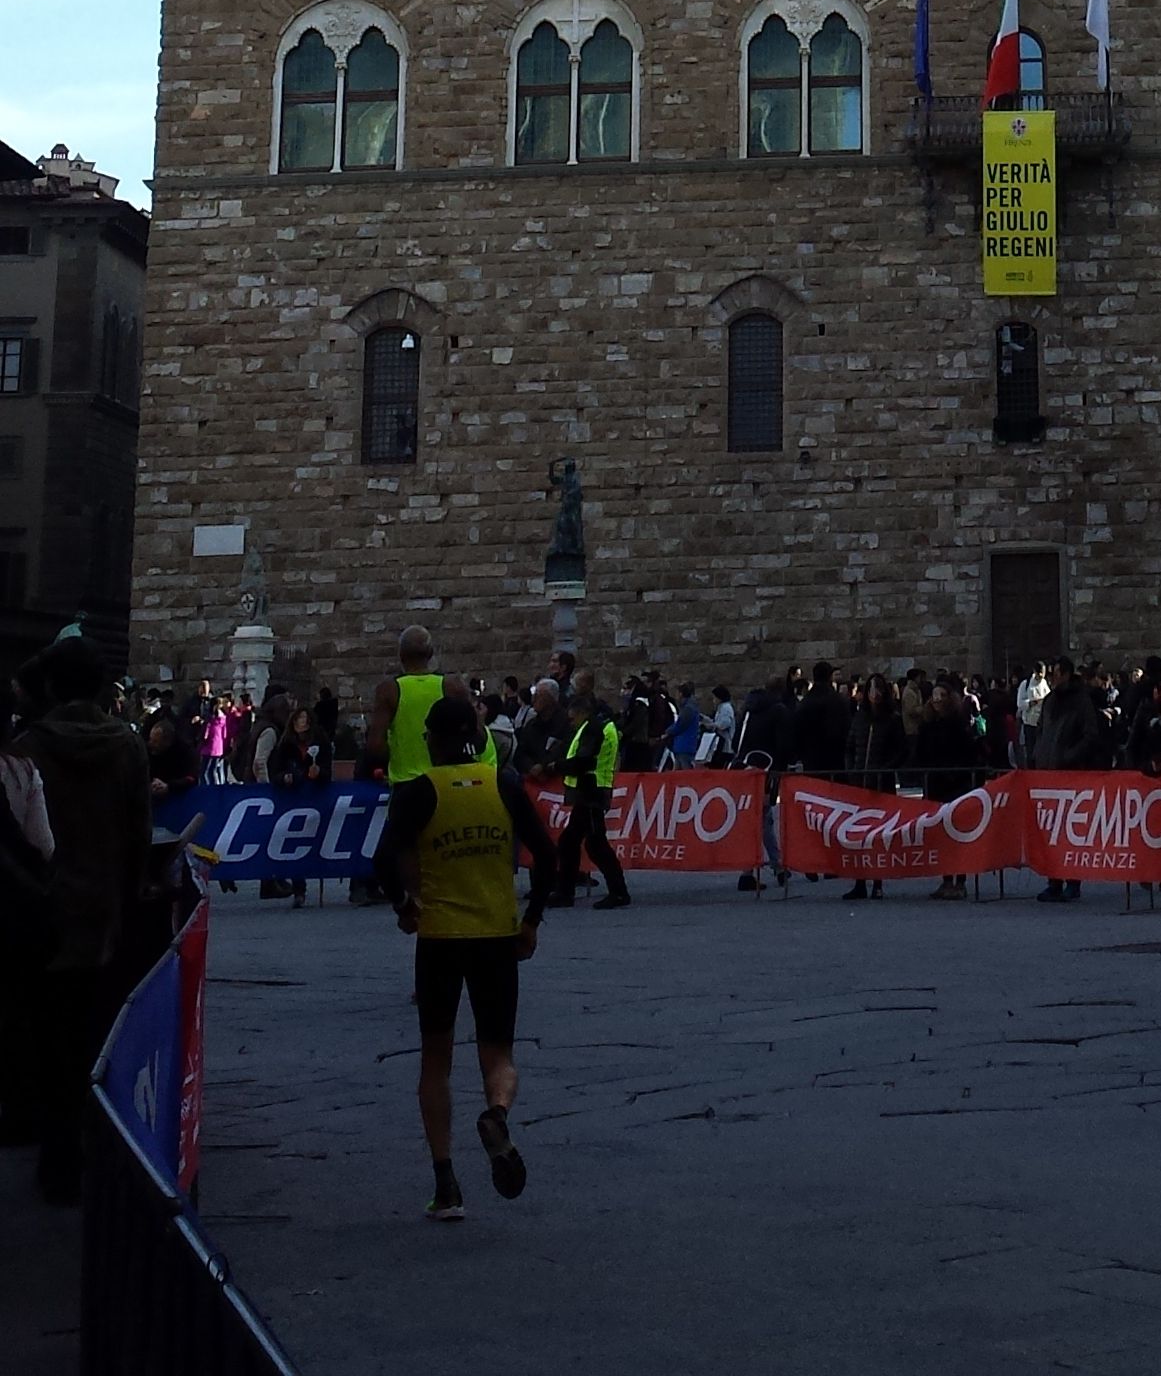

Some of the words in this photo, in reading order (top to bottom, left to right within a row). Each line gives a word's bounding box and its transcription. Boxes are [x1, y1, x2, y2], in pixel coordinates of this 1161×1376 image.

[987, 158, 1051, 184] VERITÀ
[986, 187, 1022, 208] PER
[987, 210, 1048, 231] GIULIO
[986, 236, 1054, 257] REGENI
[213, 792, 391, 863] Ceti
[432, 824, 510, 851] ATLETICA
[615, 844, 686, 861] RENZE
[841, 849, 940, 868] FIRENZE
[1063, 850, 1137, 870] FIRENZE
